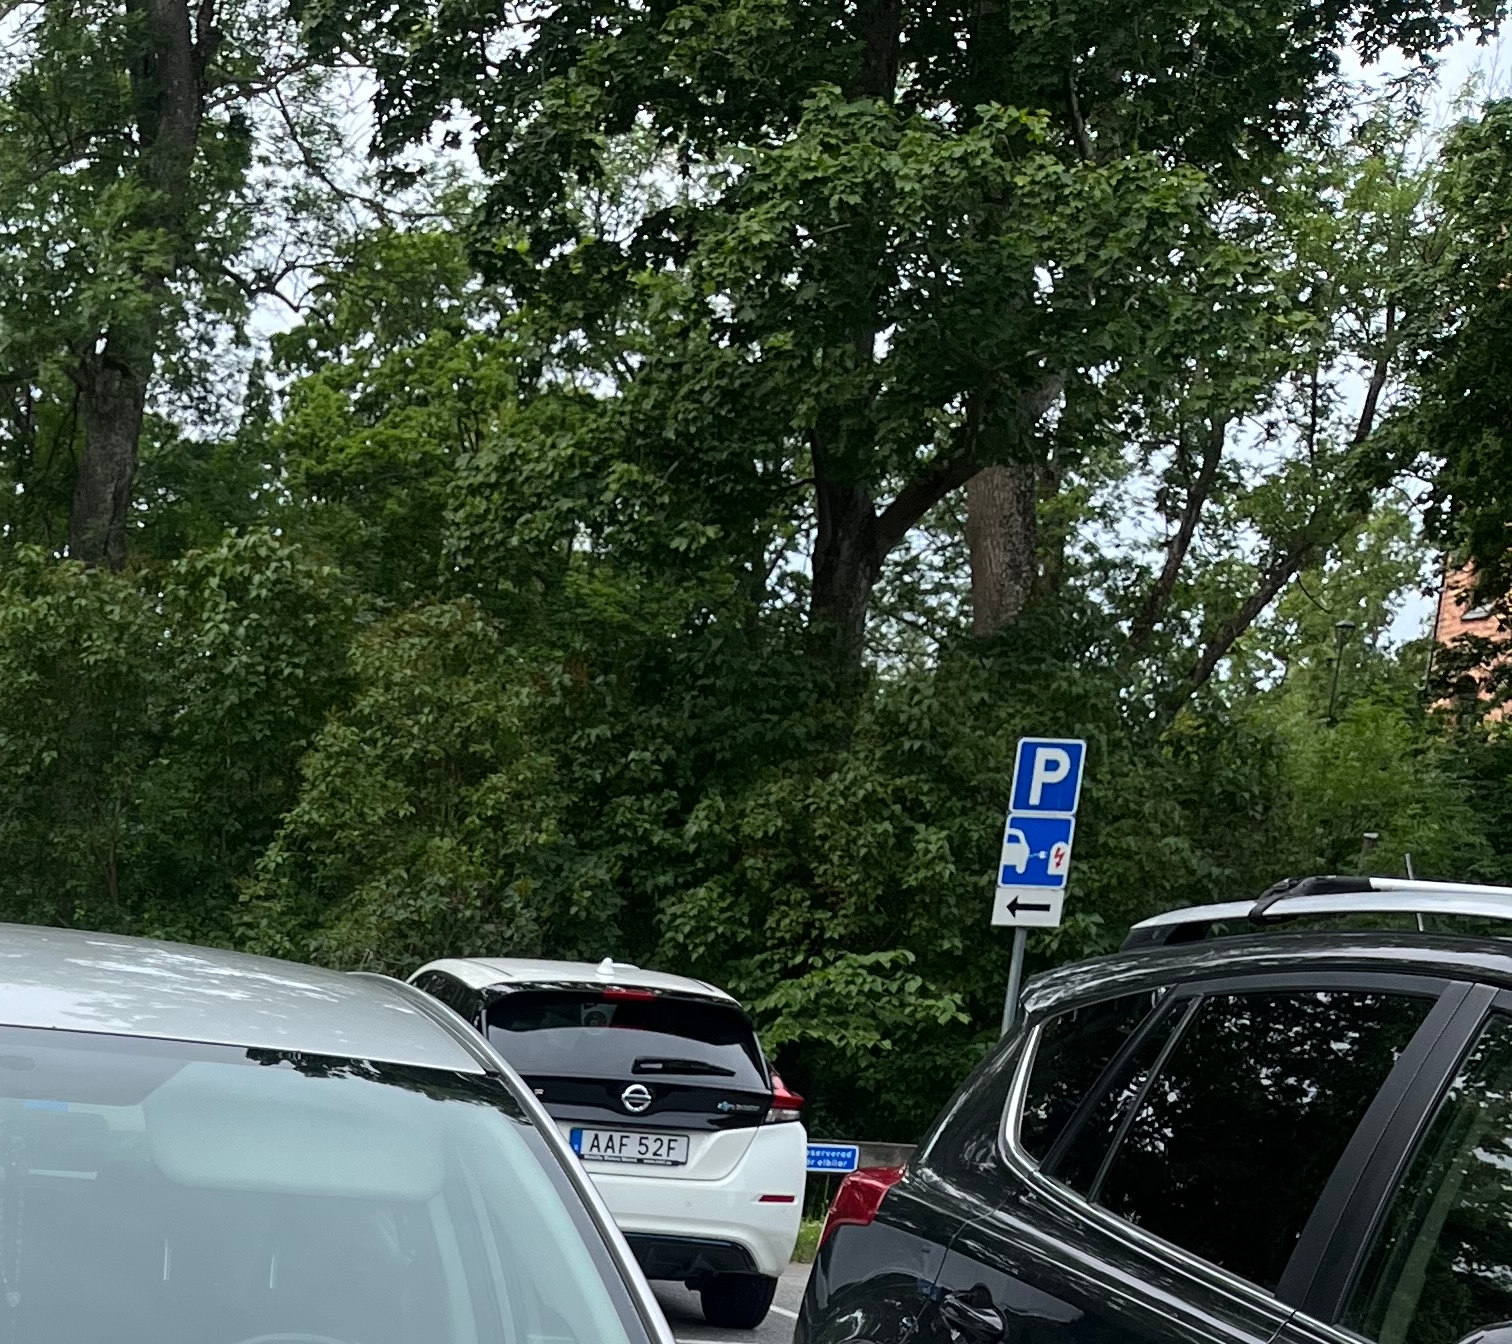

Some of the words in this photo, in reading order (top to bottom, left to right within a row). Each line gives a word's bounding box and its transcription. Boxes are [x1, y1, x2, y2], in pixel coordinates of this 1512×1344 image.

[1029, 747, 1071, 806] P
[589, 1133, 630, 1154] AAF
[638, 1136, 678, 1158] 52F
[807, 1150, 852, 1158] serverad
